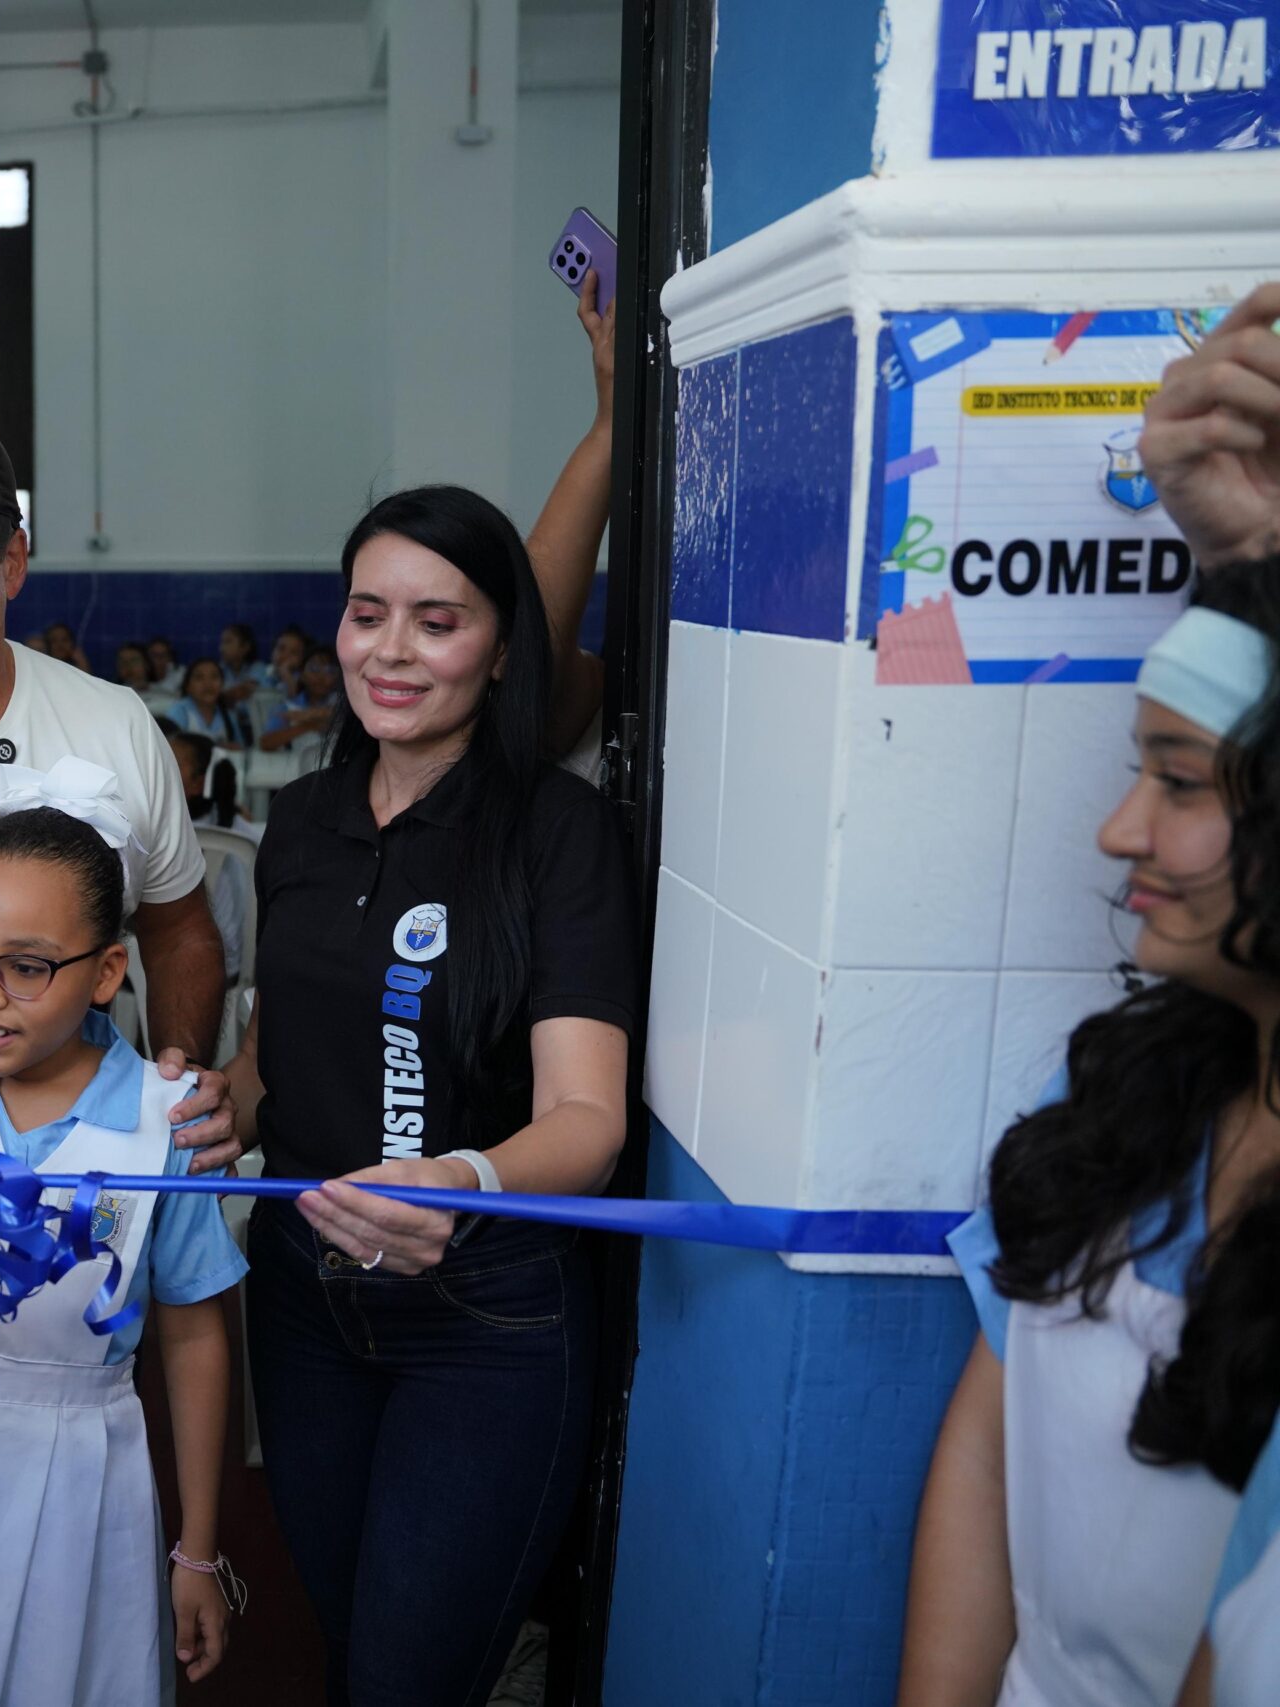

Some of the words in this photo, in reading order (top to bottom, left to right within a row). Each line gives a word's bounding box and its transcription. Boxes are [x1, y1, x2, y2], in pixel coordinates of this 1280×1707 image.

[973, 17, 1267, 99] ENTRADA
[997, 391, 1061, 409] INSTITUTO
[1064, 390, 1117, 408] TECNICO
[1120, 389, 1137, 407] DE
[951, 539, 1192, 597] COMED
[382, 963, 432, 1021] BQ
